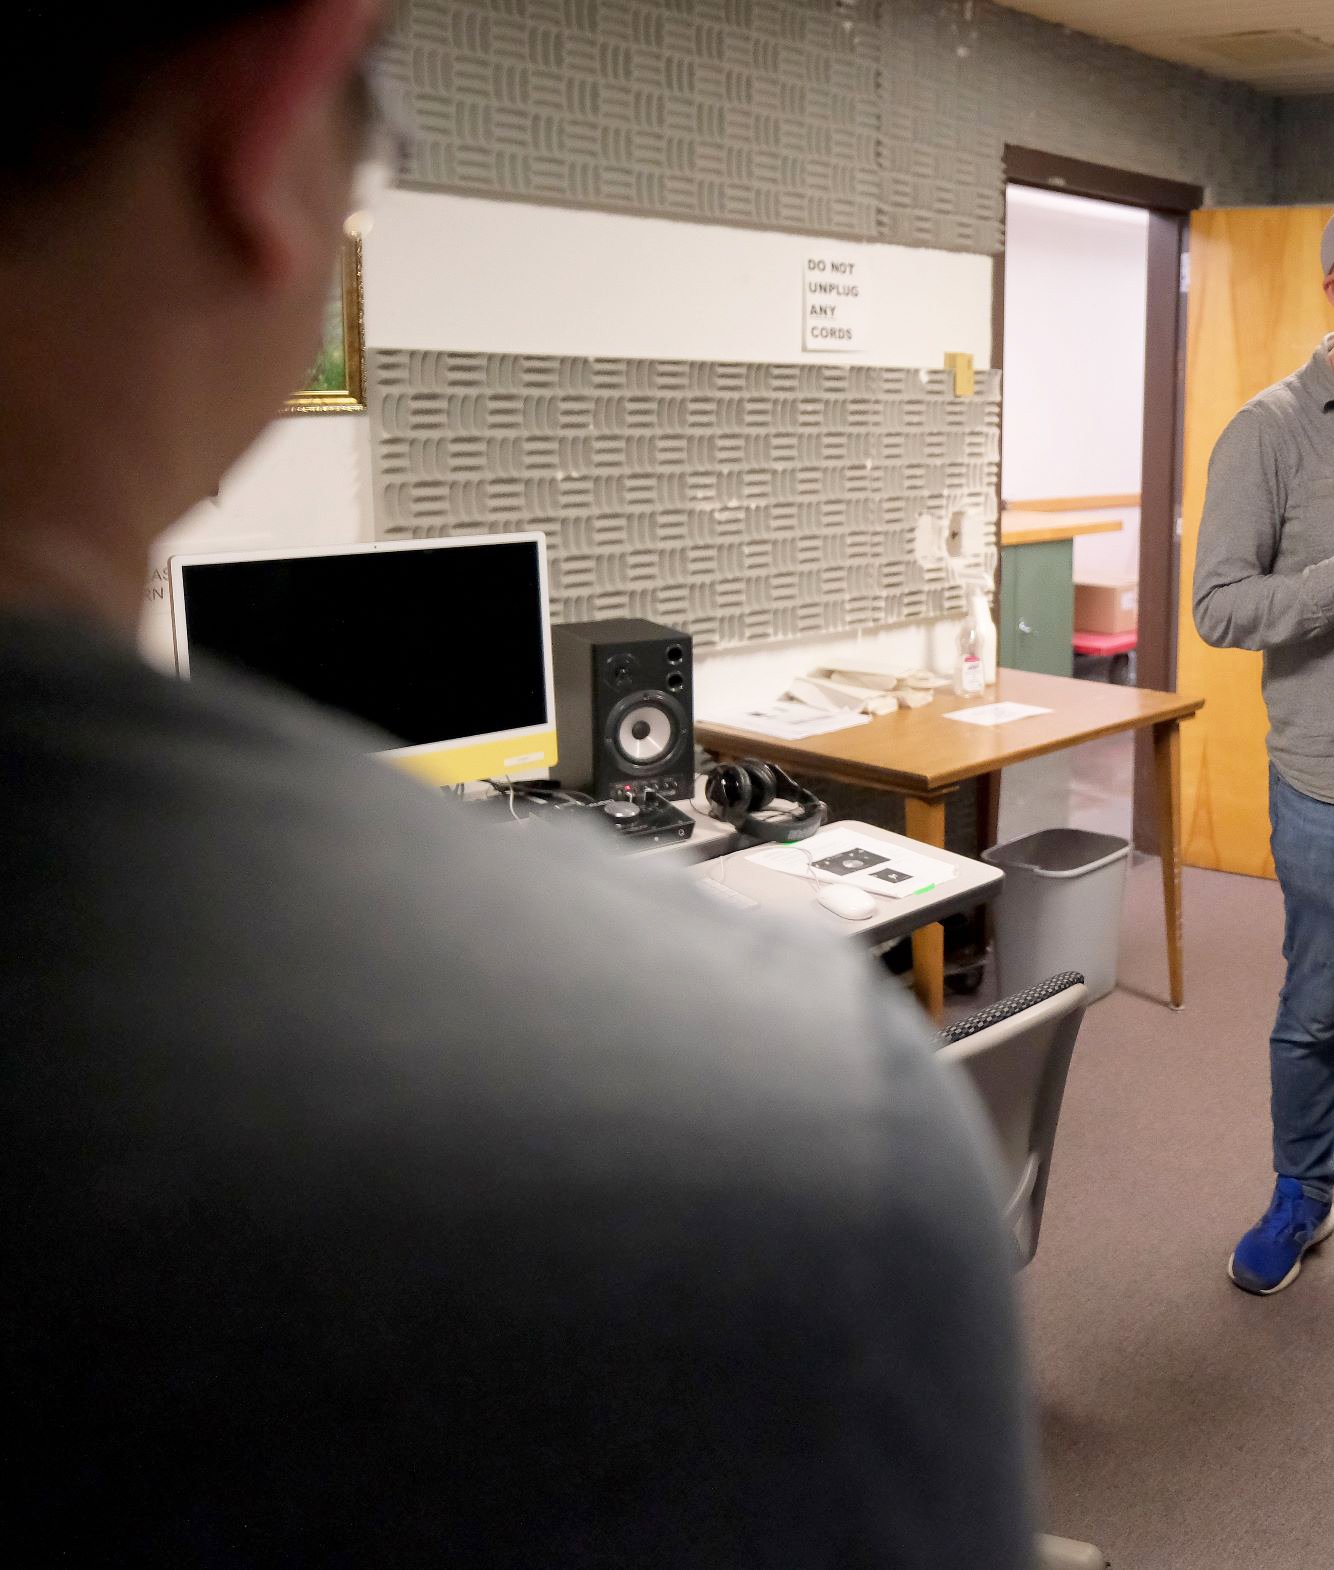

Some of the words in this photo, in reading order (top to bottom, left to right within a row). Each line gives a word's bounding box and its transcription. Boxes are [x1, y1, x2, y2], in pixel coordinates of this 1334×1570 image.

[807, 259, 826, 272] DO
[831, 262, 855, 275] NOT
[808, 281, 859, 297] UNPLUG
[810, 304, 836, 317] ANY
[811, 326, 852, 340] CORDS
